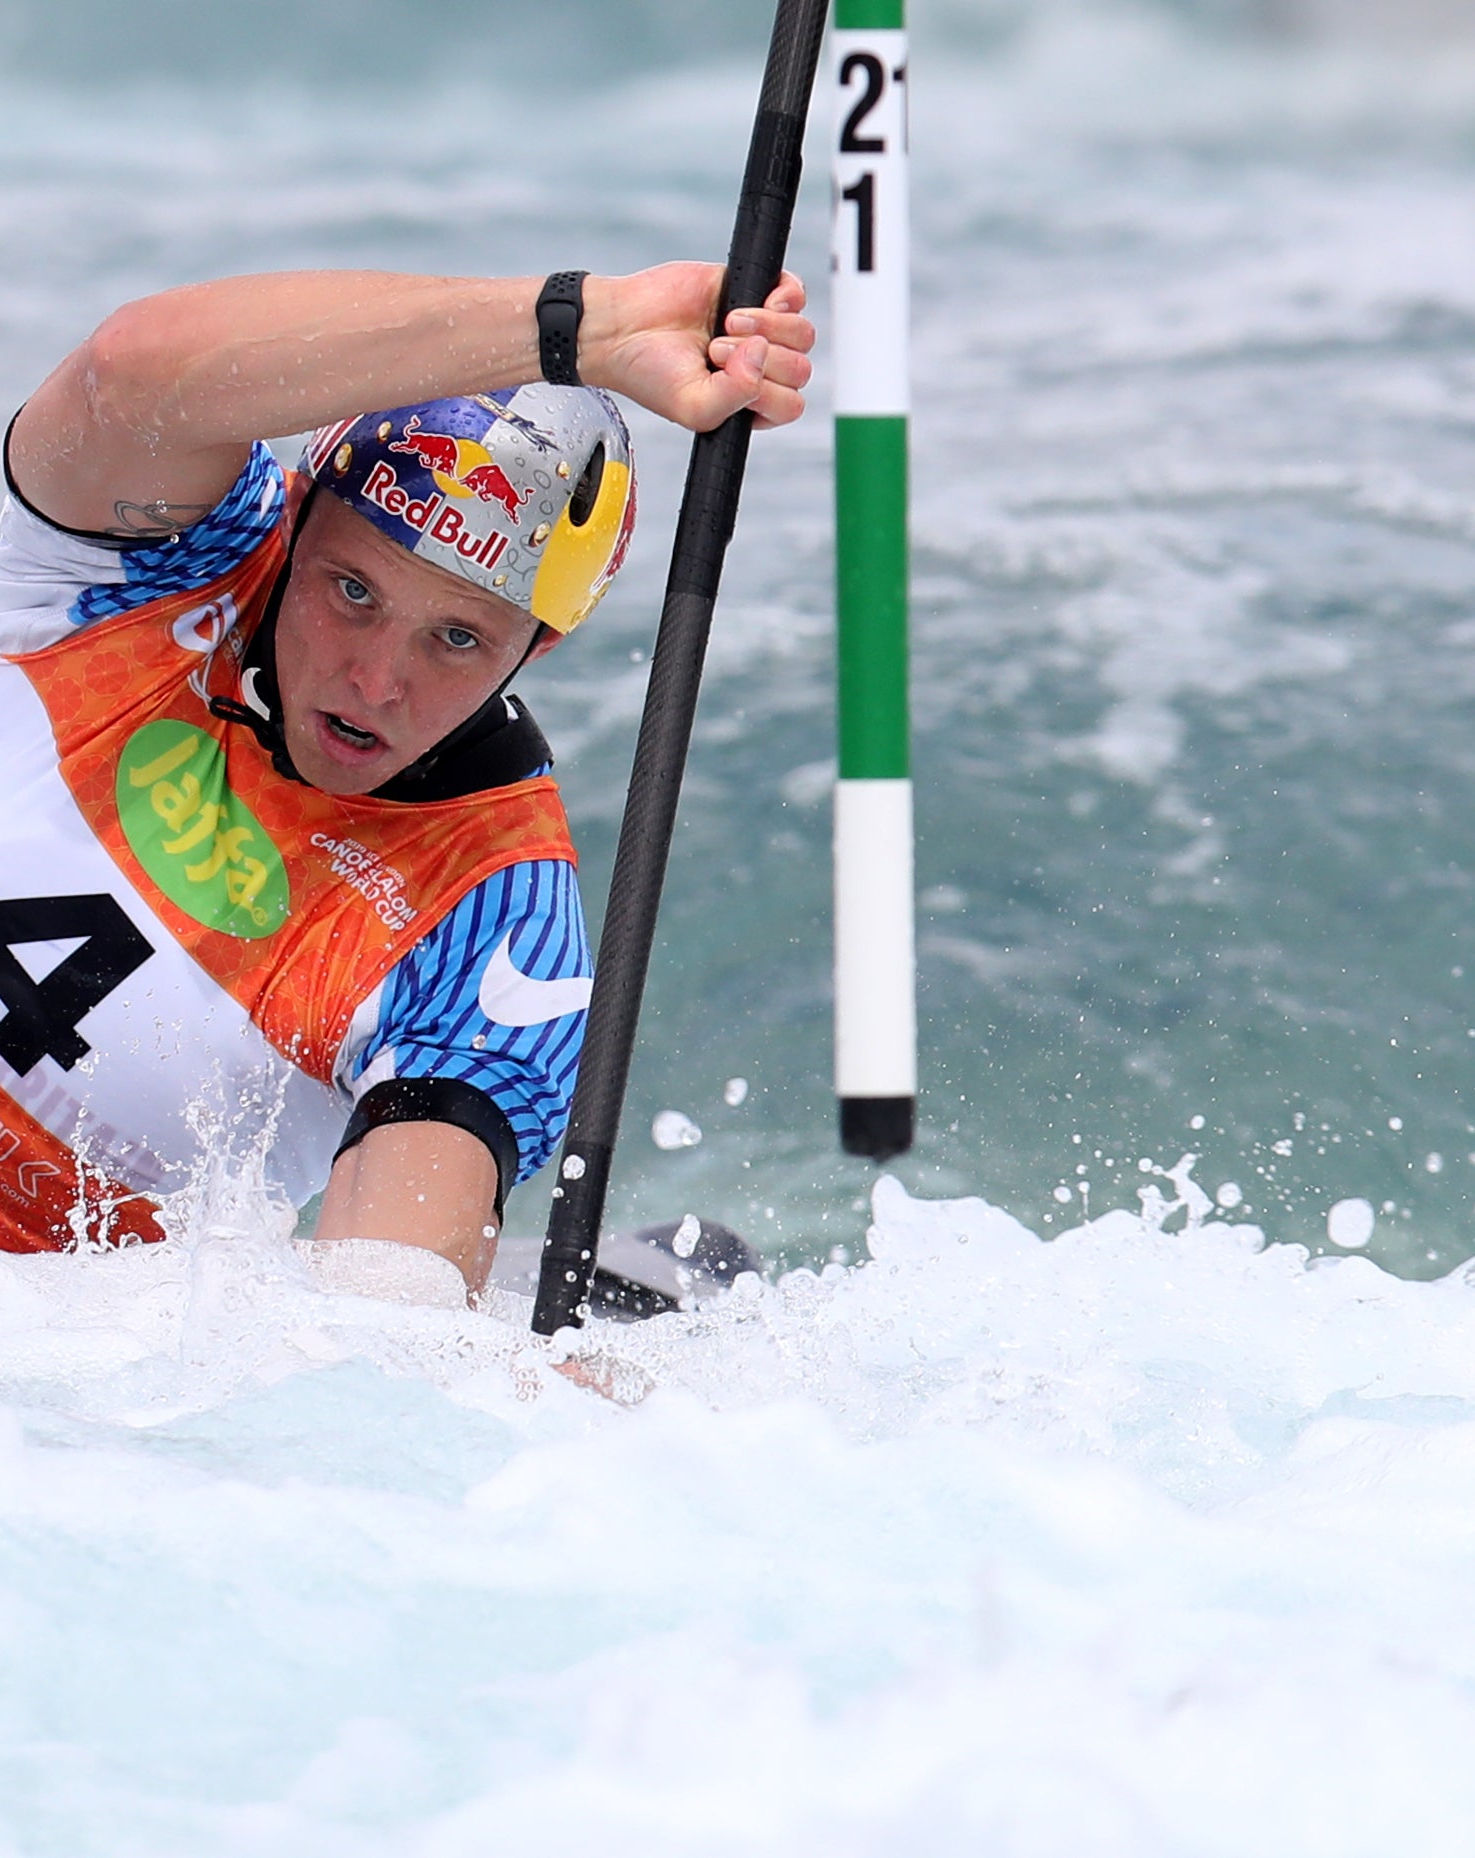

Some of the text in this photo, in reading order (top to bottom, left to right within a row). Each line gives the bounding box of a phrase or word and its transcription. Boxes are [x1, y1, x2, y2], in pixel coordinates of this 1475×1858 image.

[830, 172, 875, 272] 1
[361, 460, 509, 571] Red Bull
[309, 832, 373, 872] CANOE
[375, 899, 406, 931] CUP
